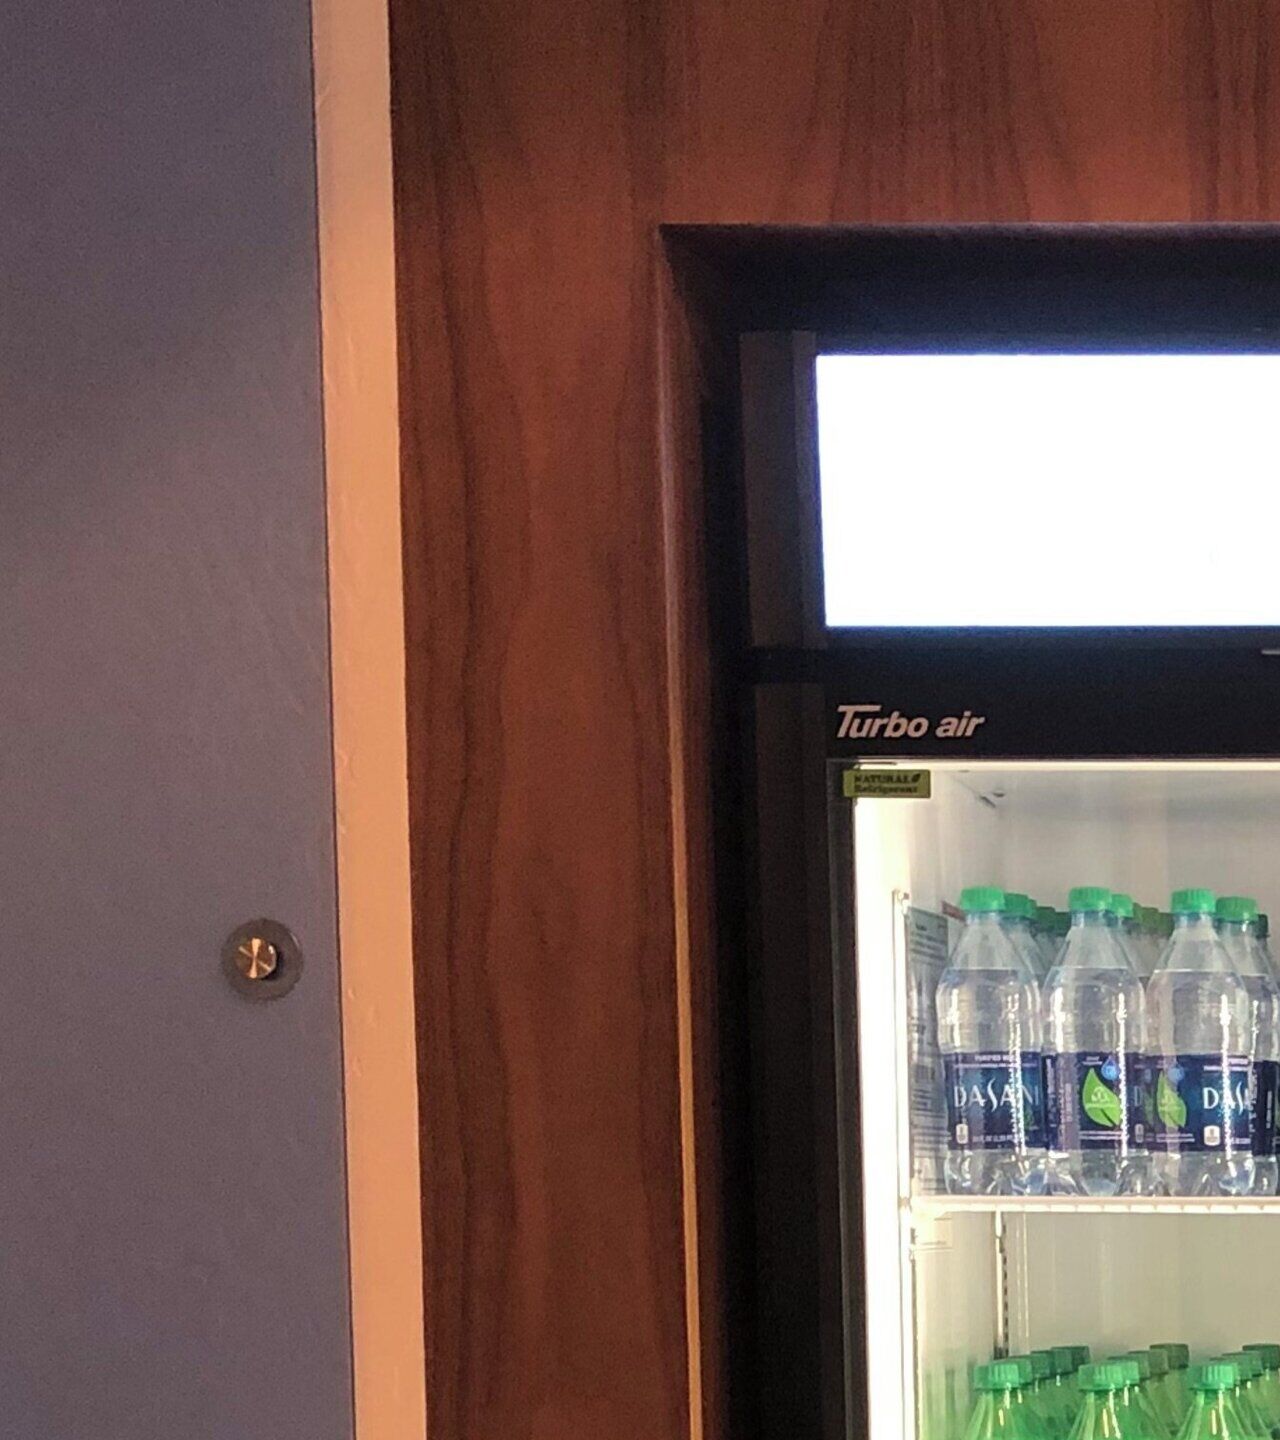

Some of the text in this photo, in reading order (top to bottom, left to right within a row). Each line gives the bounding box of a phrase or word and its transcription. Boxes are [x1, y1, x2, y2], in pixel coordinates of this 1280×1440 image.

[836, 704, 986, 738] Turbo air
[854, 774, 910, 784] NATURAL
